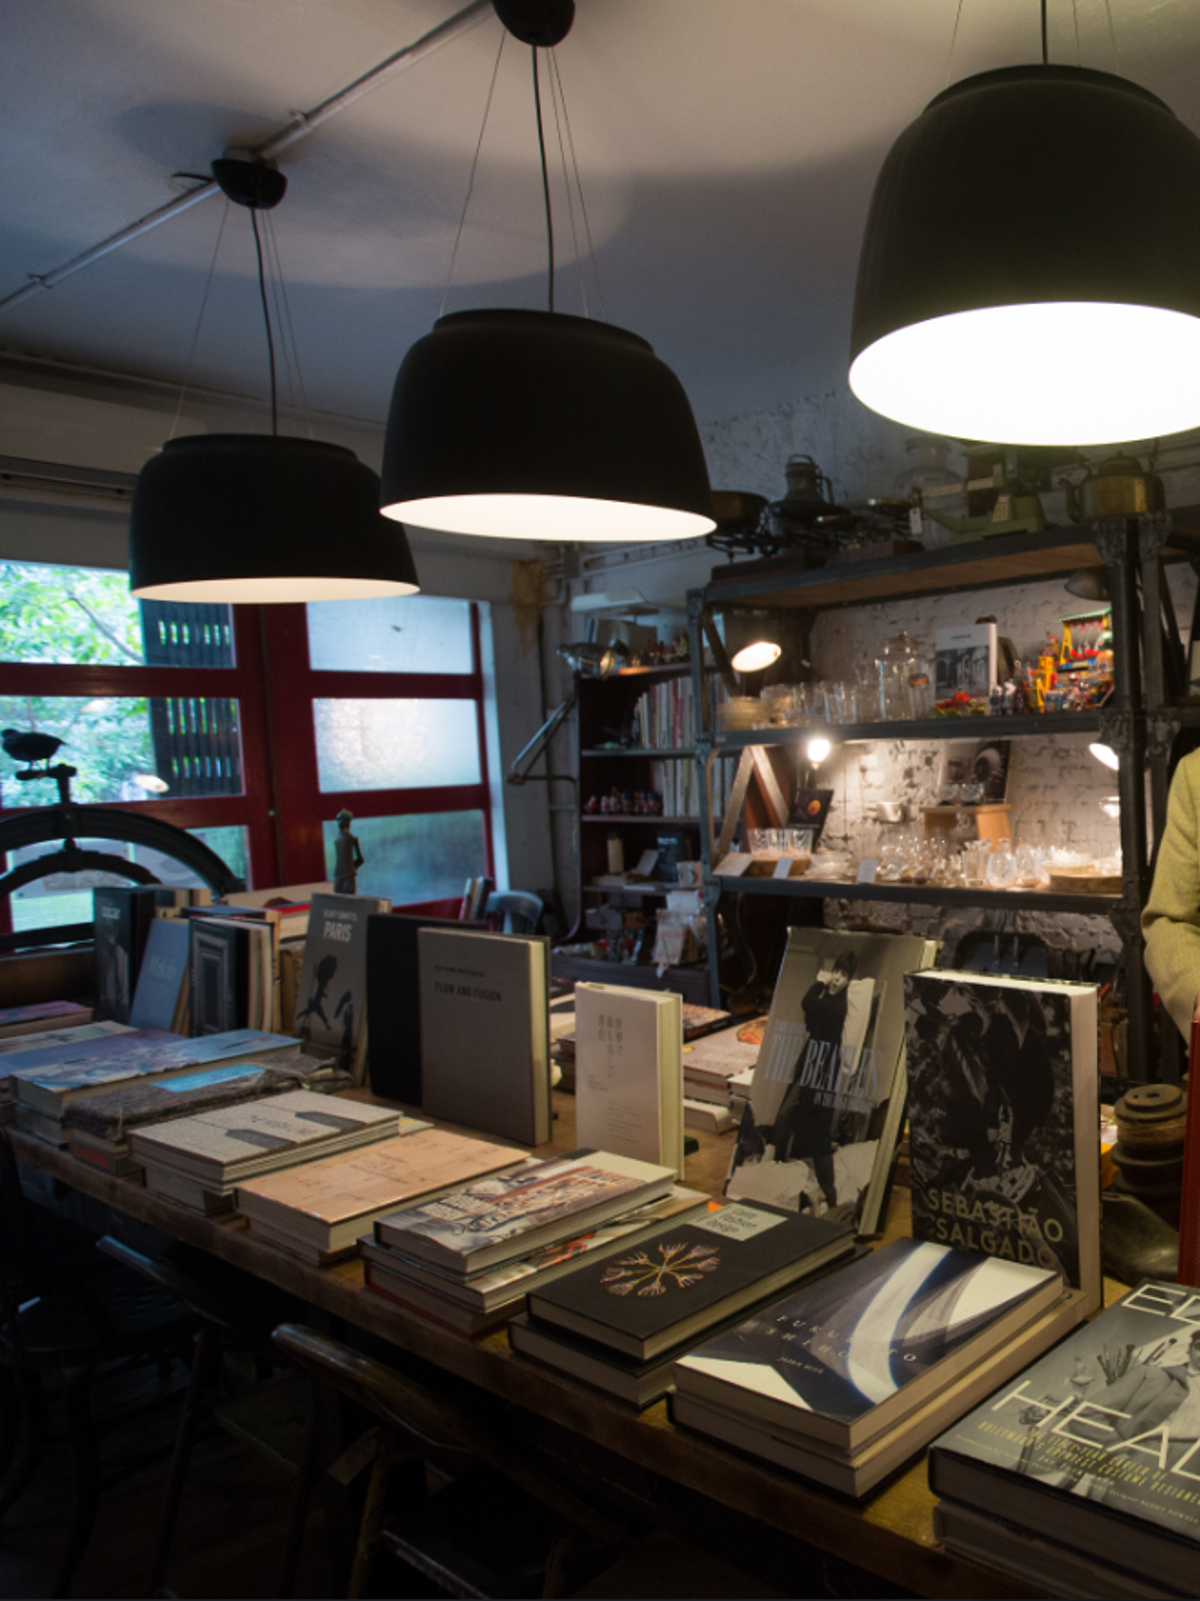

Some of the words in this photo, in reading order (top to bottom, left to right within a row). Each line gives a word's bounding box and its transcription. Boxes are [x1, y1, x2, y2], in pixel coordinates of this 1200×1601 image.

[323, 921, 353, 943] PARIS
[764, 1033, 803, 1085] THE
[800, 1037, 882, 1099] BEATLES
[927, 1187, 1064, 1243] SEBASTIÃO
[935, 1218, 1057, 1268] SALGADO
[1098, 1461, 1147, 1487] COSTUME
